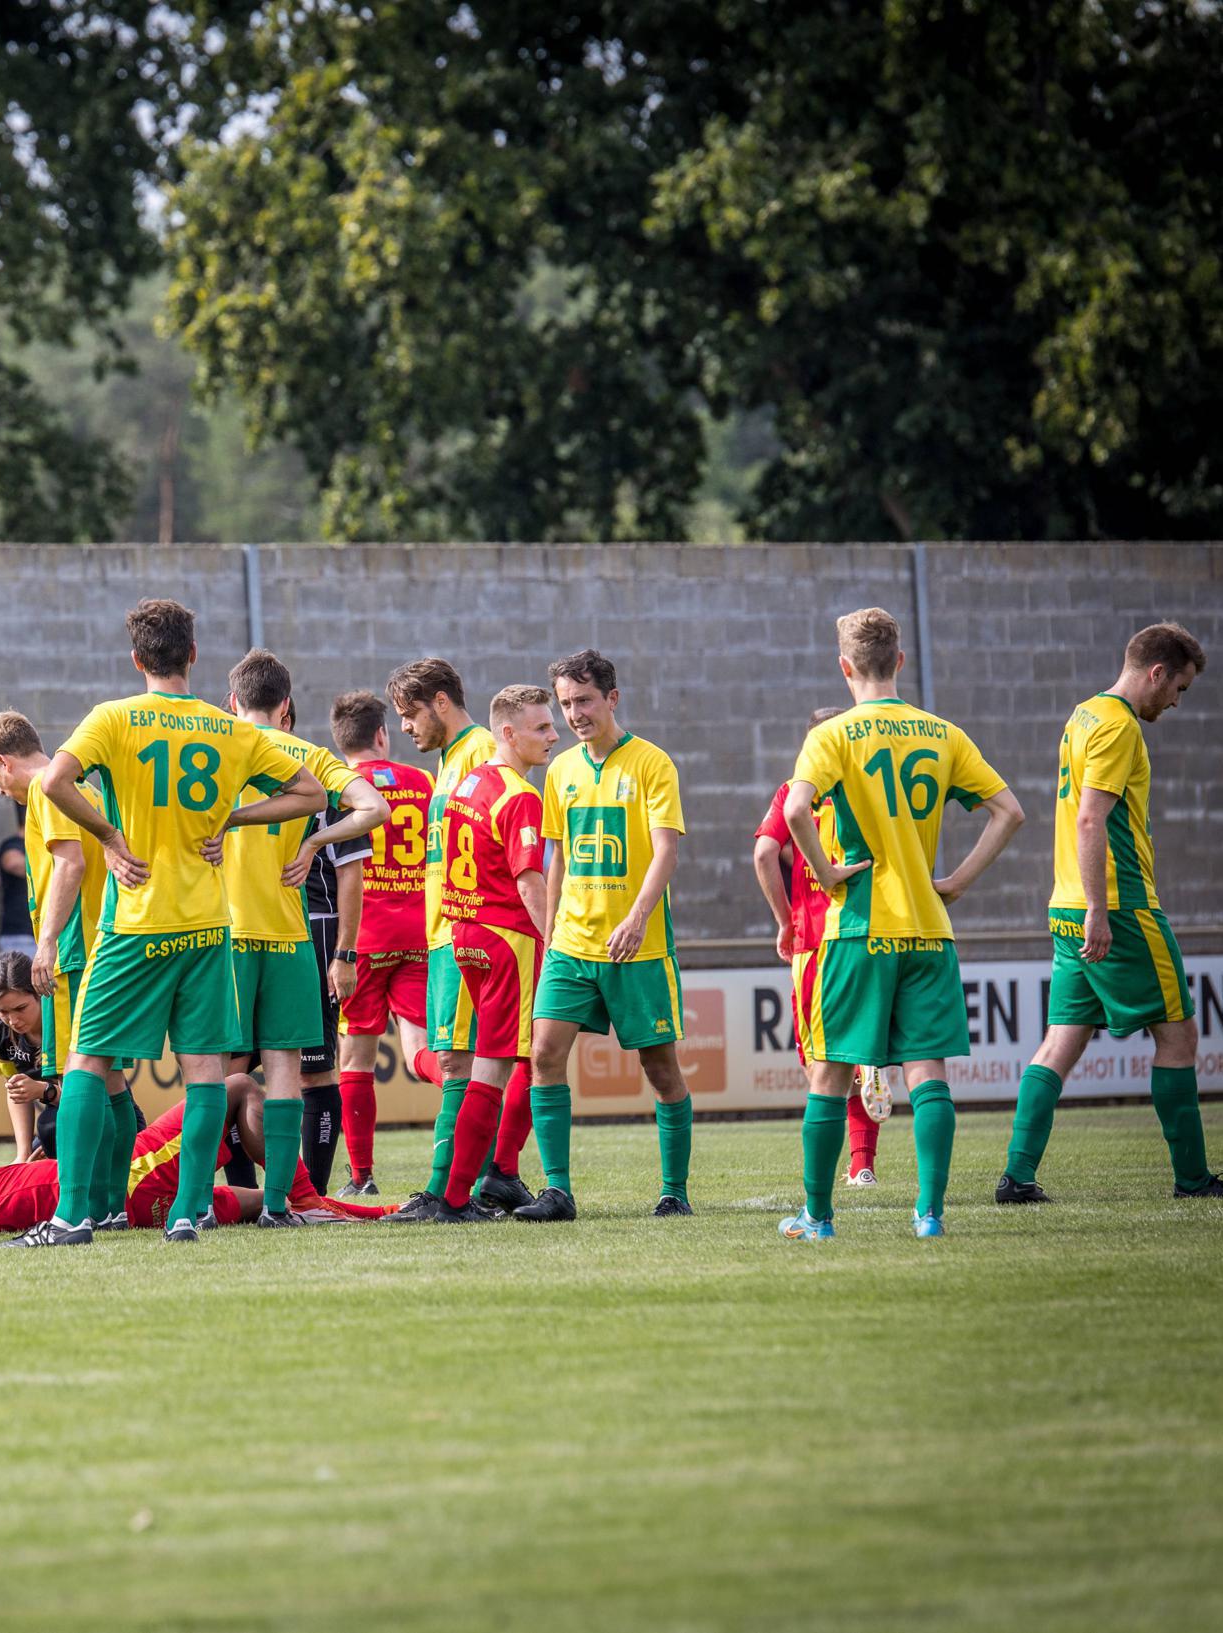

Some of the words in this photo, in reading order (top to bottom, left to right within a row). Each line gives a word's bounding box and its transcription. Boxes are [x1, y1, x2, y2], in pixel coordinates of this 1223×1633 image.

[130, 710, 156, 727] E&P
[160, 713, 234, 736] CONSTRUCT
[845, 720, 873, 741] E&P
[875, 719, 948, 740] CONSTRUCT
[136, 739, 221, 812] 18
[863, 747, 939, 820] 16
[371, 804, 426, 866] 13
[441, 816, 478, 891] 18
[363, 866, 374, 878] he
[375, 866, 400, 879] Water
[145, 927, 224, 959] C-SYSTEMS
[867, 936, 944, 956] C-SYSTEMS
